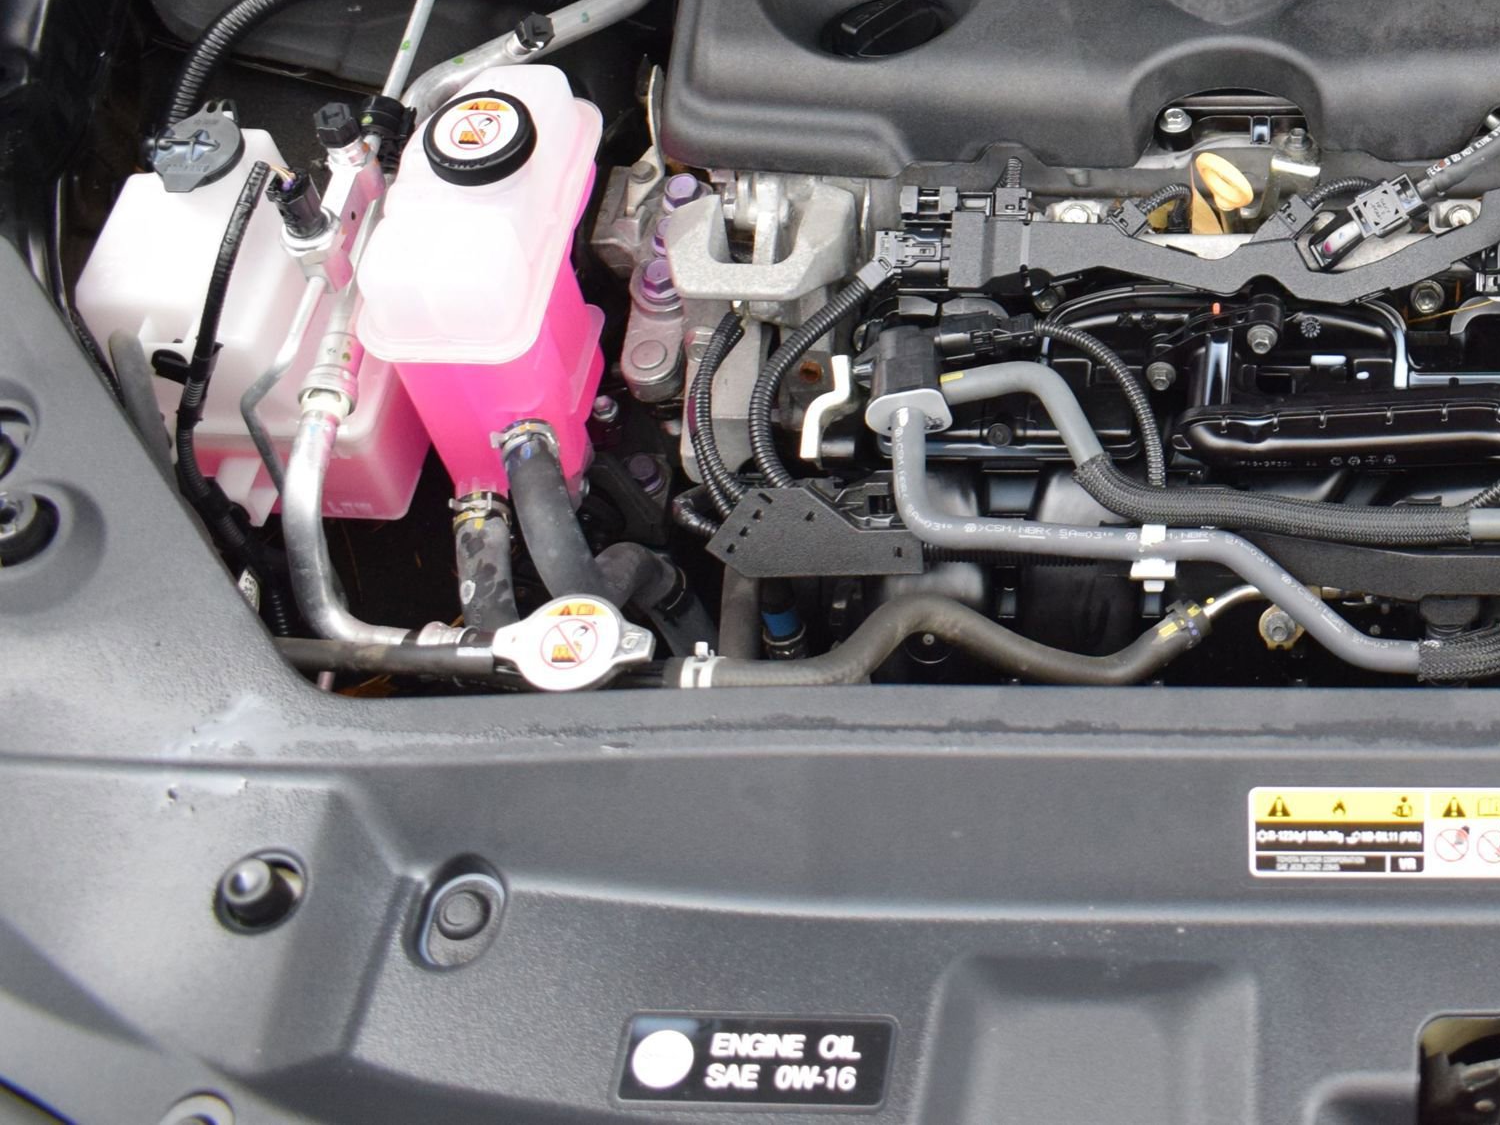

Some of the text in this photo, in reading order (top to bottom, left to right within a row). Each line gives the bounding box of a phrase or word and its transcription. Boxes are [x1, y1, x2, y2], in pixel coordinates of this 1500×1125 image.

[709, 1032, 862, 1059] ENGINE OIL
[704, 1063, 857, 1091] SAE 0W-16
